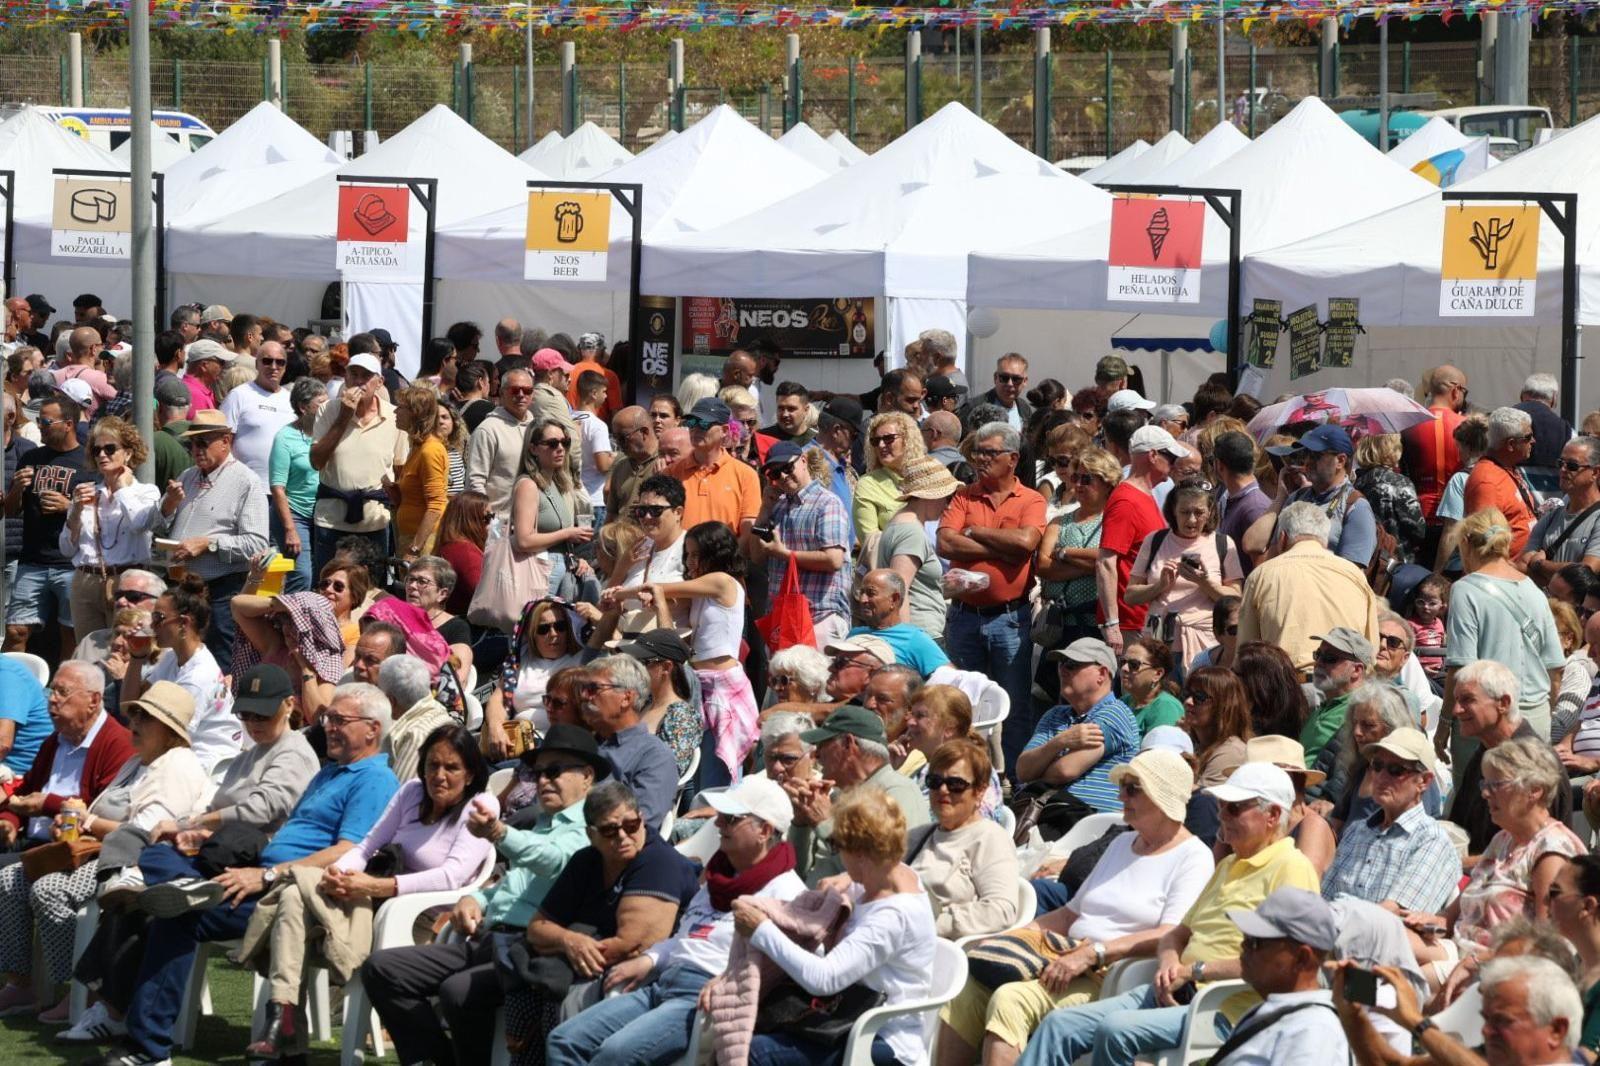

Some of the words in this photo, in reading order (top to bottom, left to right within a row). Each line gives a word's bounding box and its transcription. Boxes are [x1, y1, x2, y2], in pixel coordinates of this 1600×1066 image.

[59, 244, 124, 255] MOZZARELLA
[345, 256, 366, 265] PATA
[368, 257, 398, 266] ASADA
[553, 256, 580, 265] NEOS
[553, 267, 579, 276] BEER
[1131, 274, 1177, 285] HELADOS
[1119, 284, 1145, 295] PEÑA
[1146, 286, 1160, 296] LA
[1161, 286, 1189, 297] VIEJA
[1451, 286, 1506, 297] GUARAPO
[1509, 286, 1525, 297] DE
[1450, 297, 1484, 310] CAÑA
[1485, 299, 1523, 310] DULCE
[739, 309, 809, 329] NEOS
